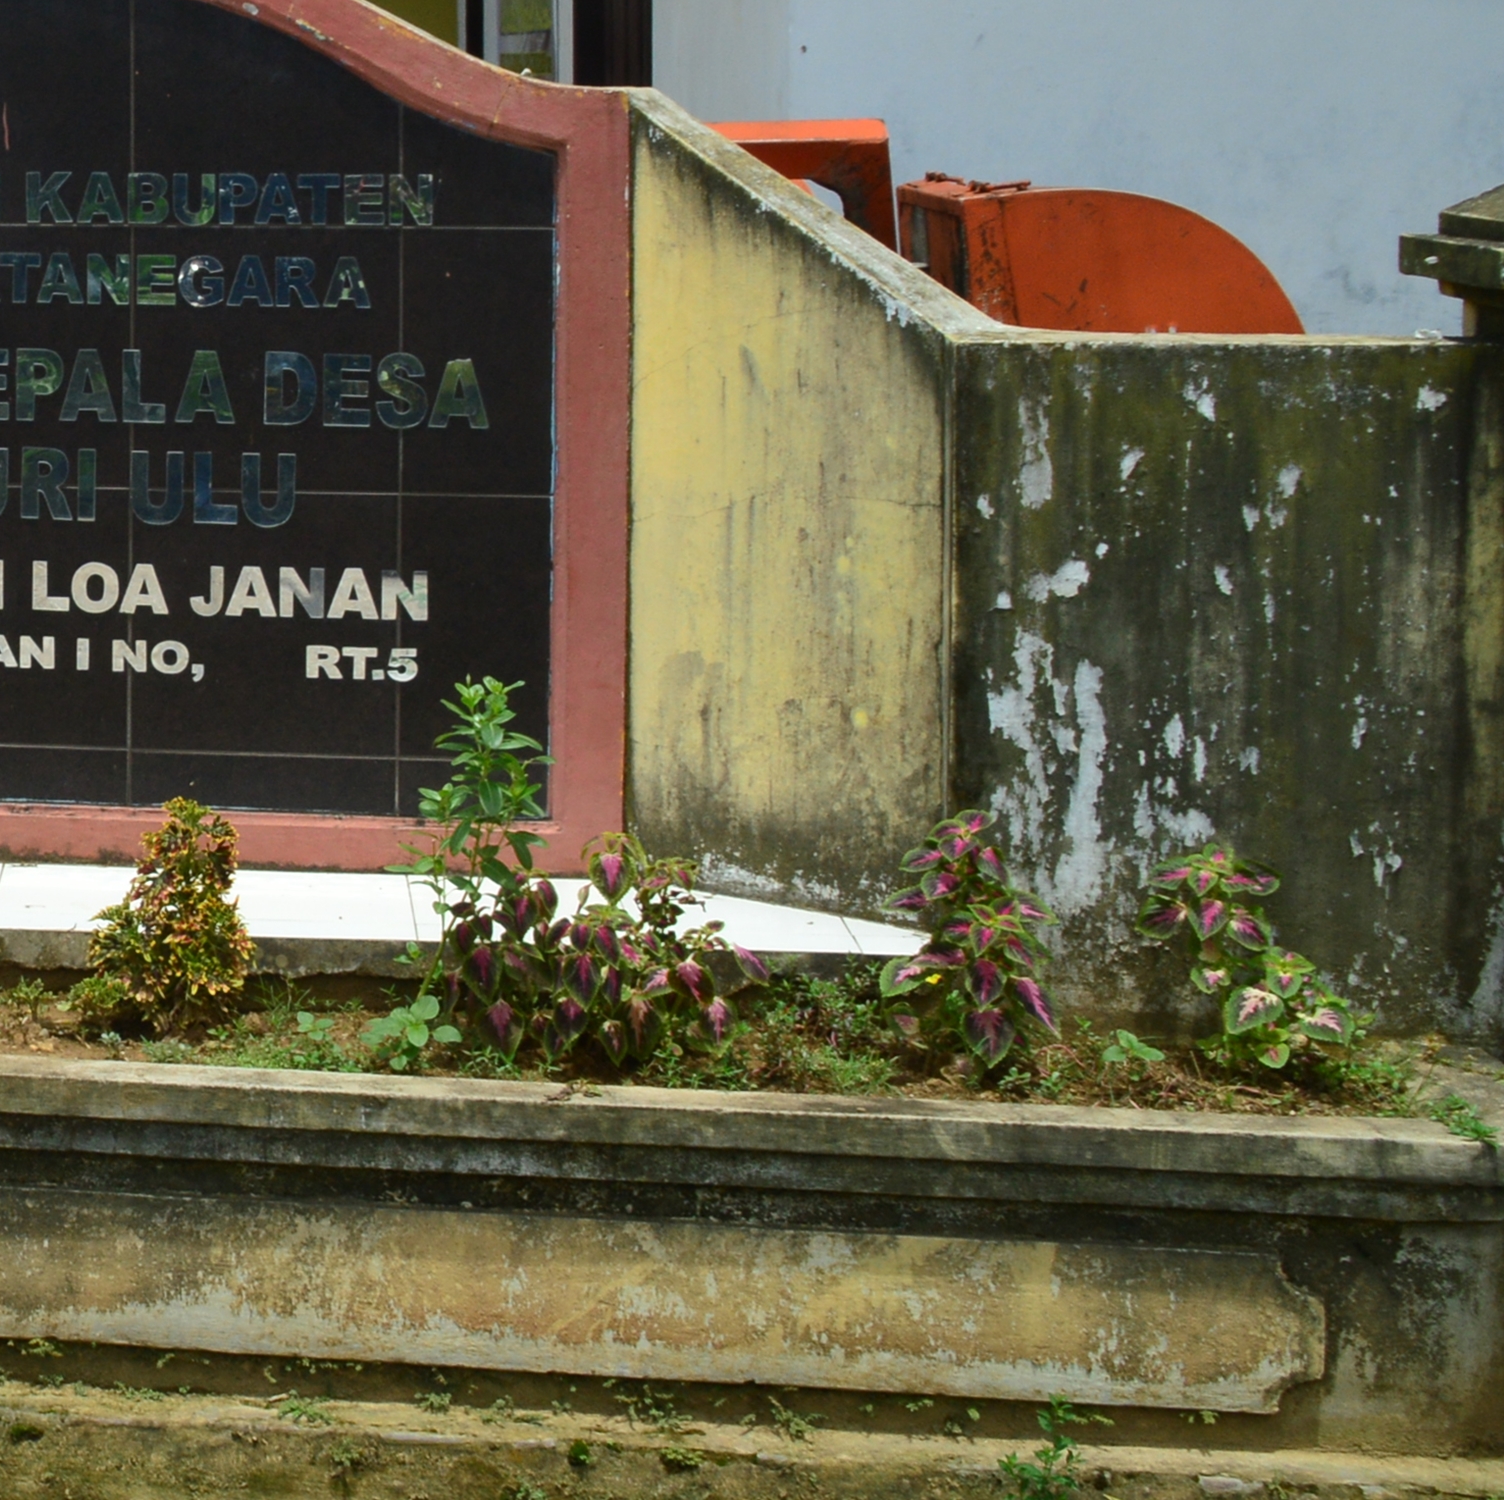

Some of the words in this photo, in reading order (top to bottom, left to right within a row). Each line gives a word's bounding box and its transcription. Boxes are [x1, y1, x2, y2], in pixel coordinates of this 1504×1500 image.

[25, 171, 434, 226] KABUPATEN
[263, 350, 490, 430] DESA
[130, 449, 297, 529] ULU
[32, 560, 169, 615] LOA
[190, 565, 428, 622] JANAN
[76, 637, 90, 671] I
[112, 639, 205, 683] NO,
[306, 645, 419, 682] RT.5
